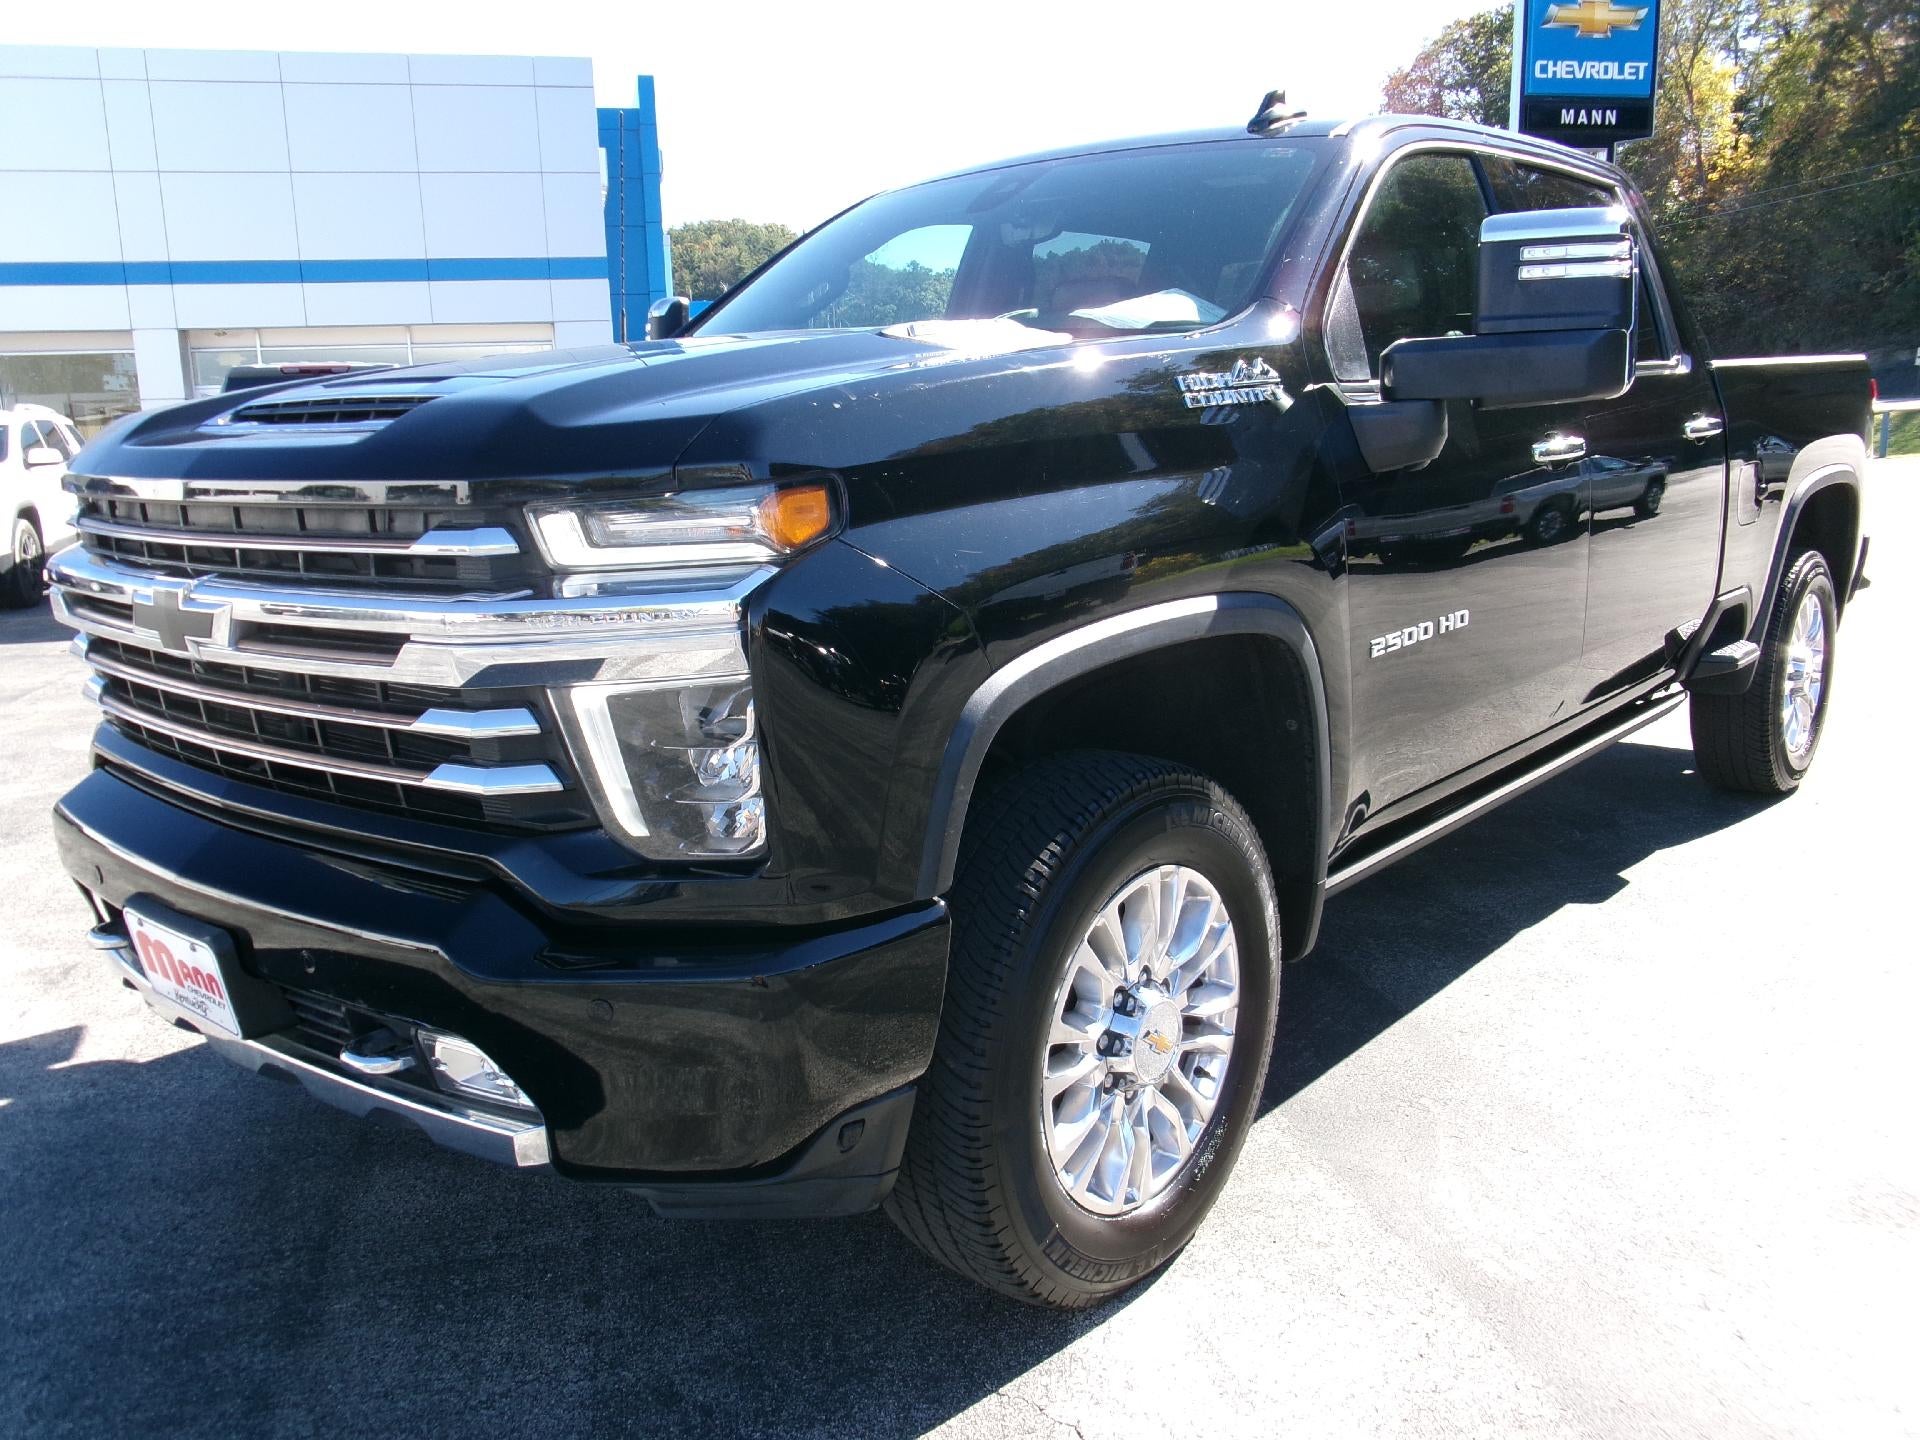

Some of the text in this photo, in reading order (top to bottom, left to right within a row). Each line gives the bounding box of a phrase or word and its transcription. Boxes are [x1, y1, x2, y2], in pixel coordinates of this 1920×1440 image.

[1535, 60, 1648, 80] CHEVROLET
[1561, 108, 1617, 126] MANN
[1183, 386, 1284, 408] COUNTRY
[590, 608, 702, 624] COUNTRY
[1369, 609, 1469, 658] 2500 HD
[187, 984, 226, 1010] CHEVROLET
[1047, 1236, 1134, 1283] MICHELIN
